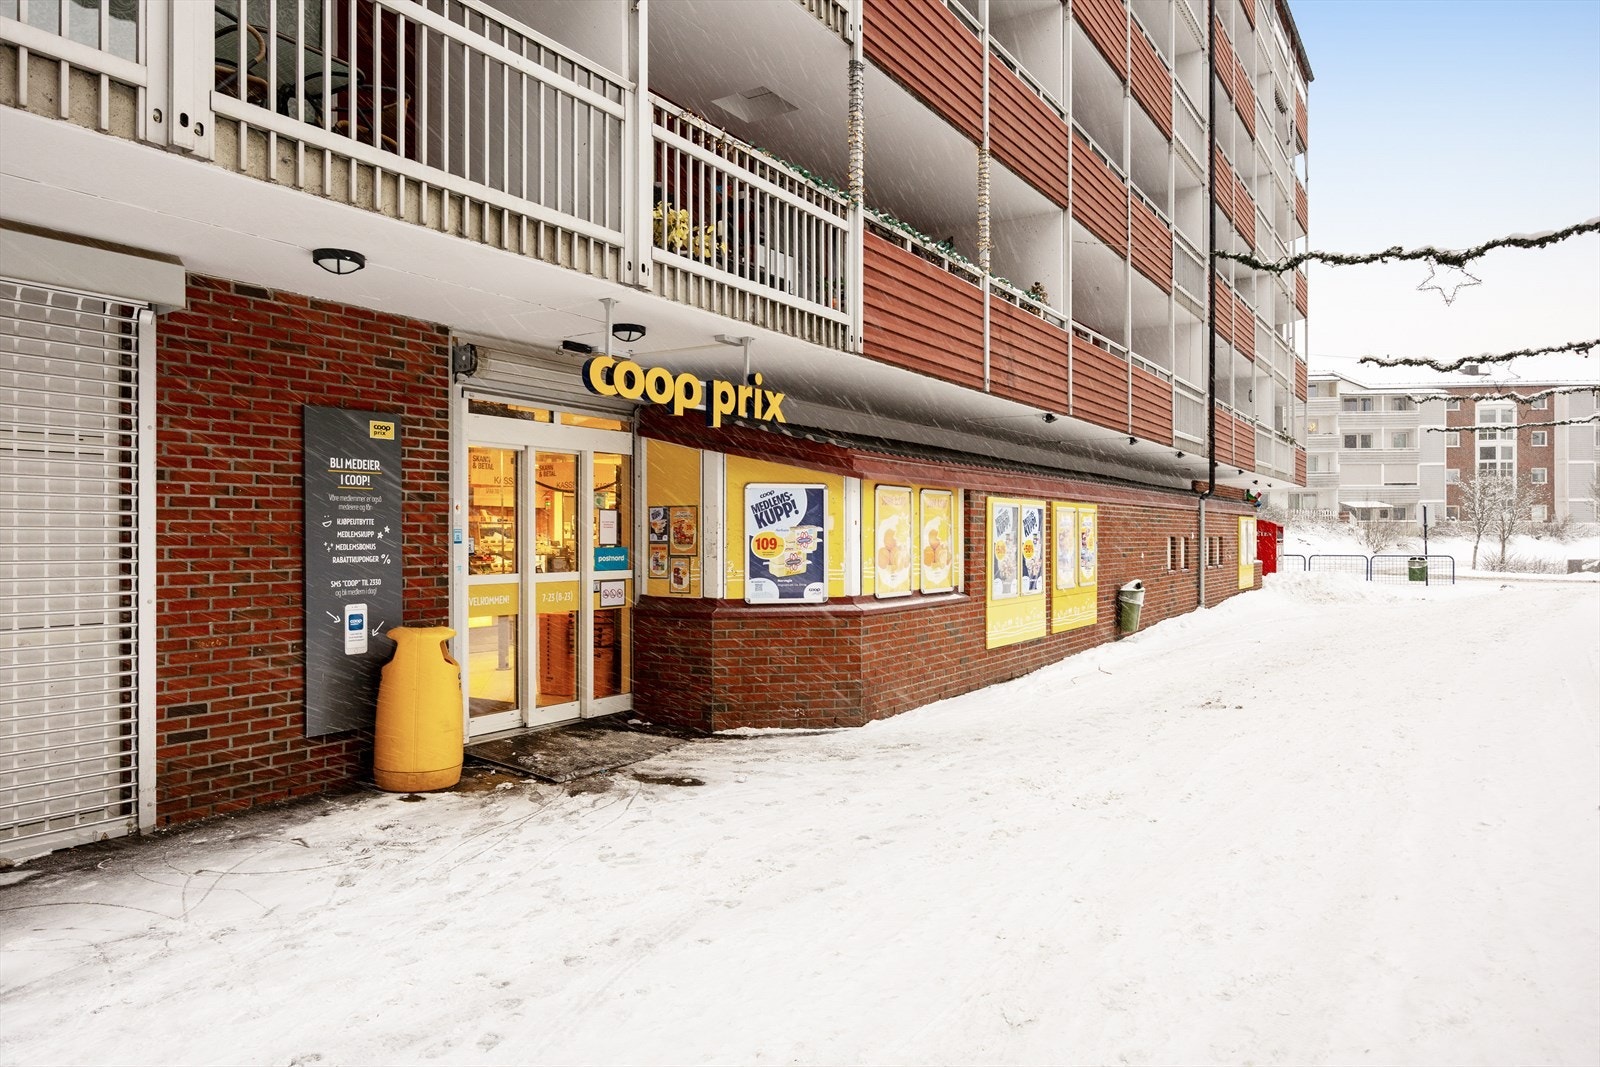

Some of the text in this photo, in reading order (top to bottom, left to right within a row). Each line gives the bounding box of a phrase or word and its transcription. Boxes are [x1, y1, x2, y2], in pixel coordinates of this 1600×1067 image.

[583, 355, 787, 429] coop prix
[374, 424, 391, 432] coop
[329, 457, 381, 471] BLI MEDEIER
[340, 474, 371, 487] I COOP!
[340, 495, 366, 503] medlemmer
[760, 490, 775, 499] coop
[750, 491, 793, 515] MEDLEMS-
[754, 499, 799, 529] KUPP!
[336, 518, 375, 526] KJØPEUTBYTTE
[337, 530, 375, 538] MEDLEMSKUPP
[335, 543, 377, 551] MEDLEMSBONUS
[755, 537, 778, 551] 109
[332, 555, 380, 564] RABATTKUPONGER
[598, 554, 625, 563] postnord
[330, 580, 342, 588] SMS
[342, 579, 361, 587] "COOP"
[361, 578, 369, 586] TIL
[335, 589, 342, 598] og
[347, 587, 366, 596] medlem
[541, 592, 555, 603] 7-23
[469, 595, 510, 607] VELKOMMEN!
